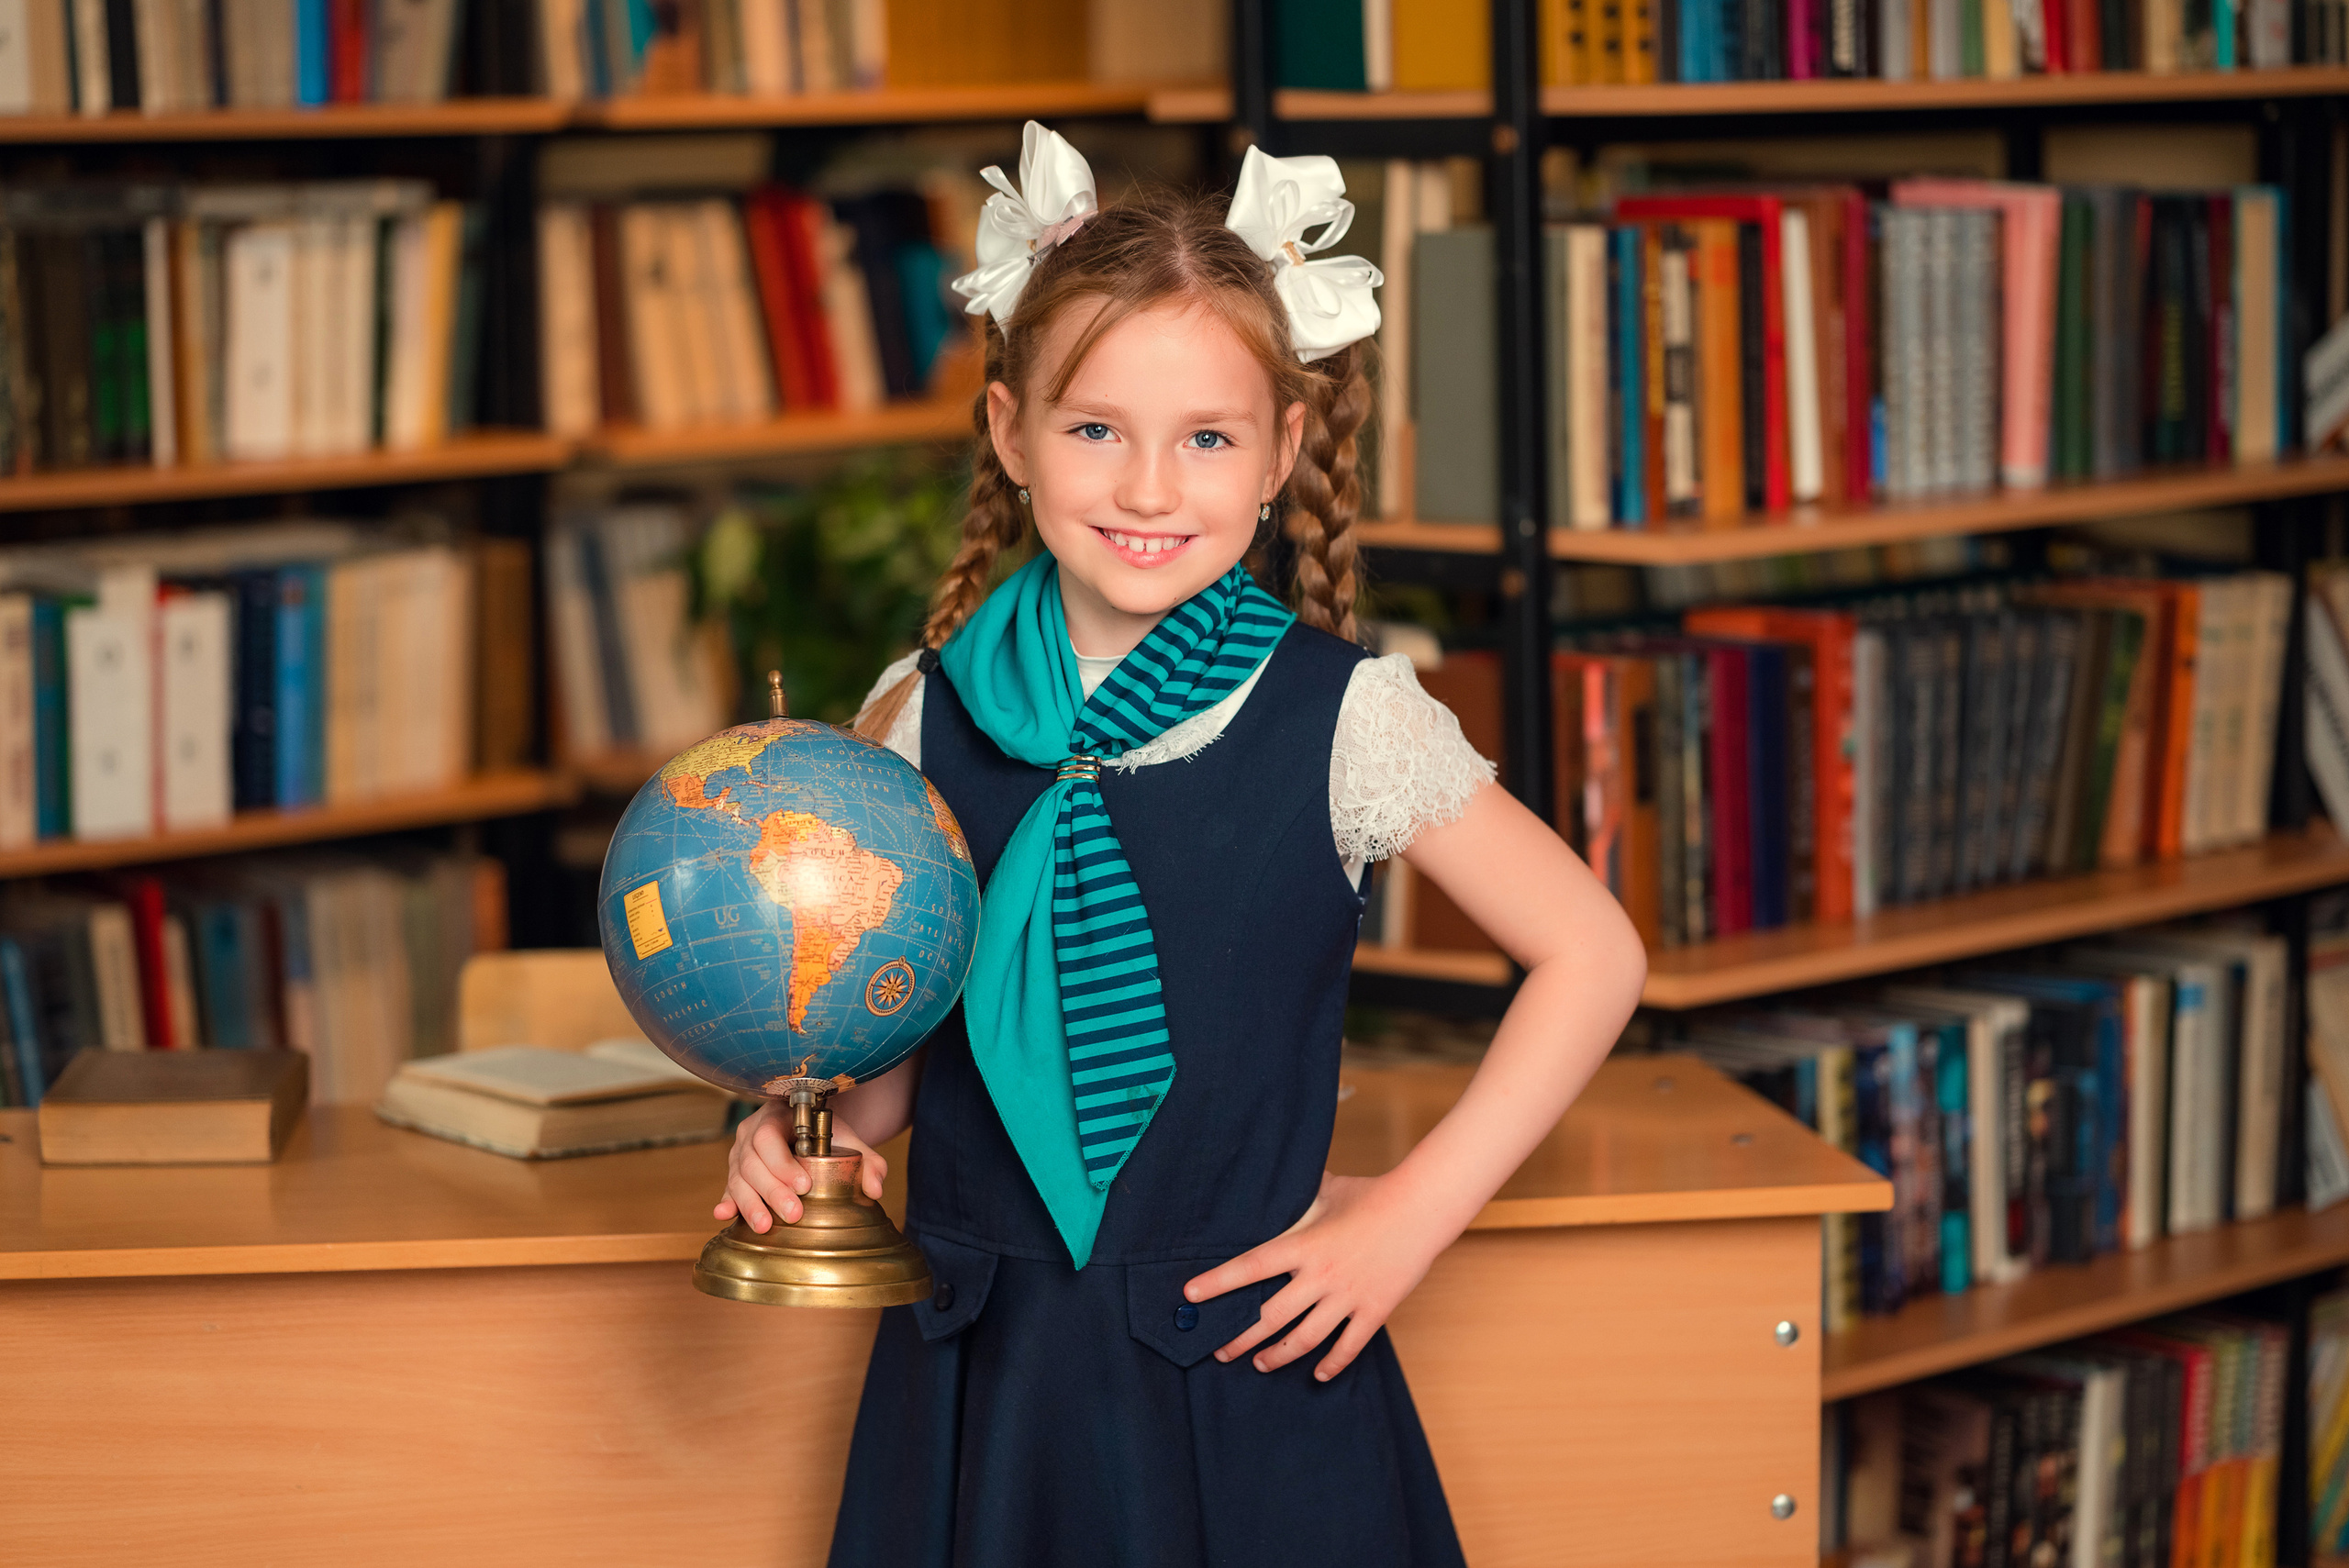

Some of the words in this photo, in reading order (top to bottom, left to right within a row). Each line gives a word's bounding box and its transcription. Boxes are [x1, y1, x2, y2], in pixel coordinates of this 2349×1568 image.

[827, 749, 875, 759] NORTH
[826, 762, 901, 779] ATLANTIC
[839, 780, 889, 793] OCEAN
[715, 906, 740, 925] UG
[919, 924, 965, 952] ATLNTIC
[654, 981, 687, 1003] SOUTH
[662, 999, 708, 1023] PACIFIC
[682, 1022, 717, 1040] OCEAN
